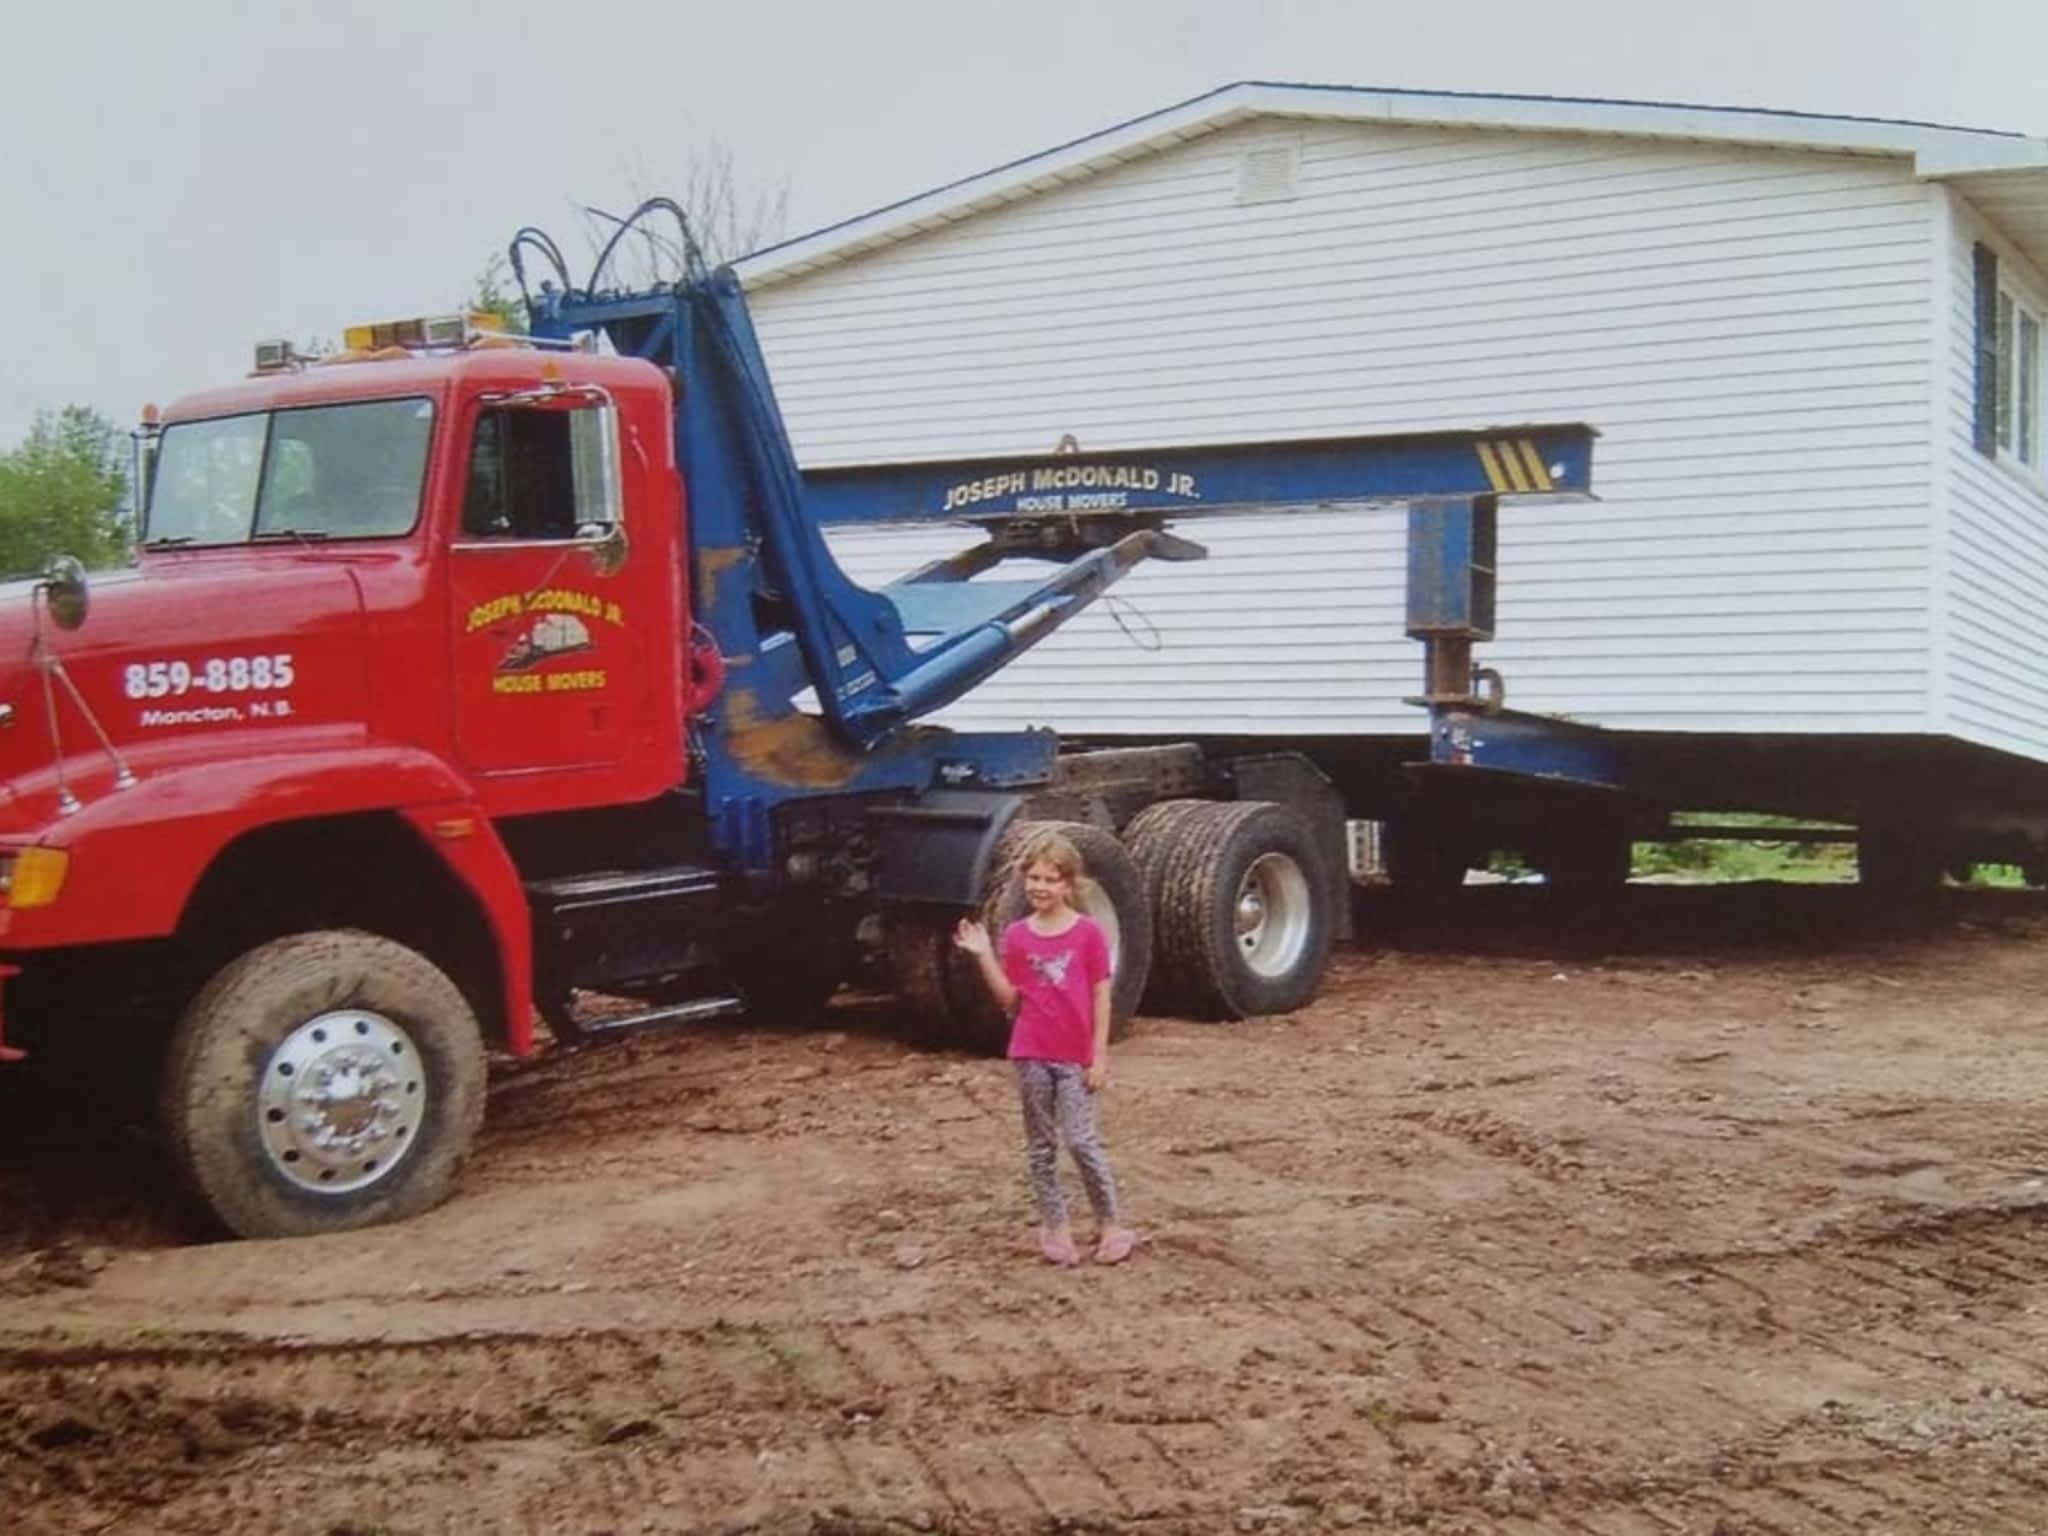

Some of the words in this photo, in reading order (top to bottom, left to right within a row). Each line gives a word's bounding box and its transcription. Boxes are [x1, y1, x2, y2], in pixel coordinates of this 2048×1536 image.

[943, 471, 1025, 511] JOSEPH
[1033, 466, 1159, 490] McDONALD
[1167, 472, 1201, 498] JR.
[1016, 495, 1063, 512] HOUSE
[1068, 491, 1128, 509] MOVERS
[466, 595, 522, 632] JOSEPH
[125, 654, 295, 699] 859-8885
[493, 674, 542, 693] HOUSE
[547, 671, 607, 691] MOVERS
[140, 706, 245, 727] Moncton,
